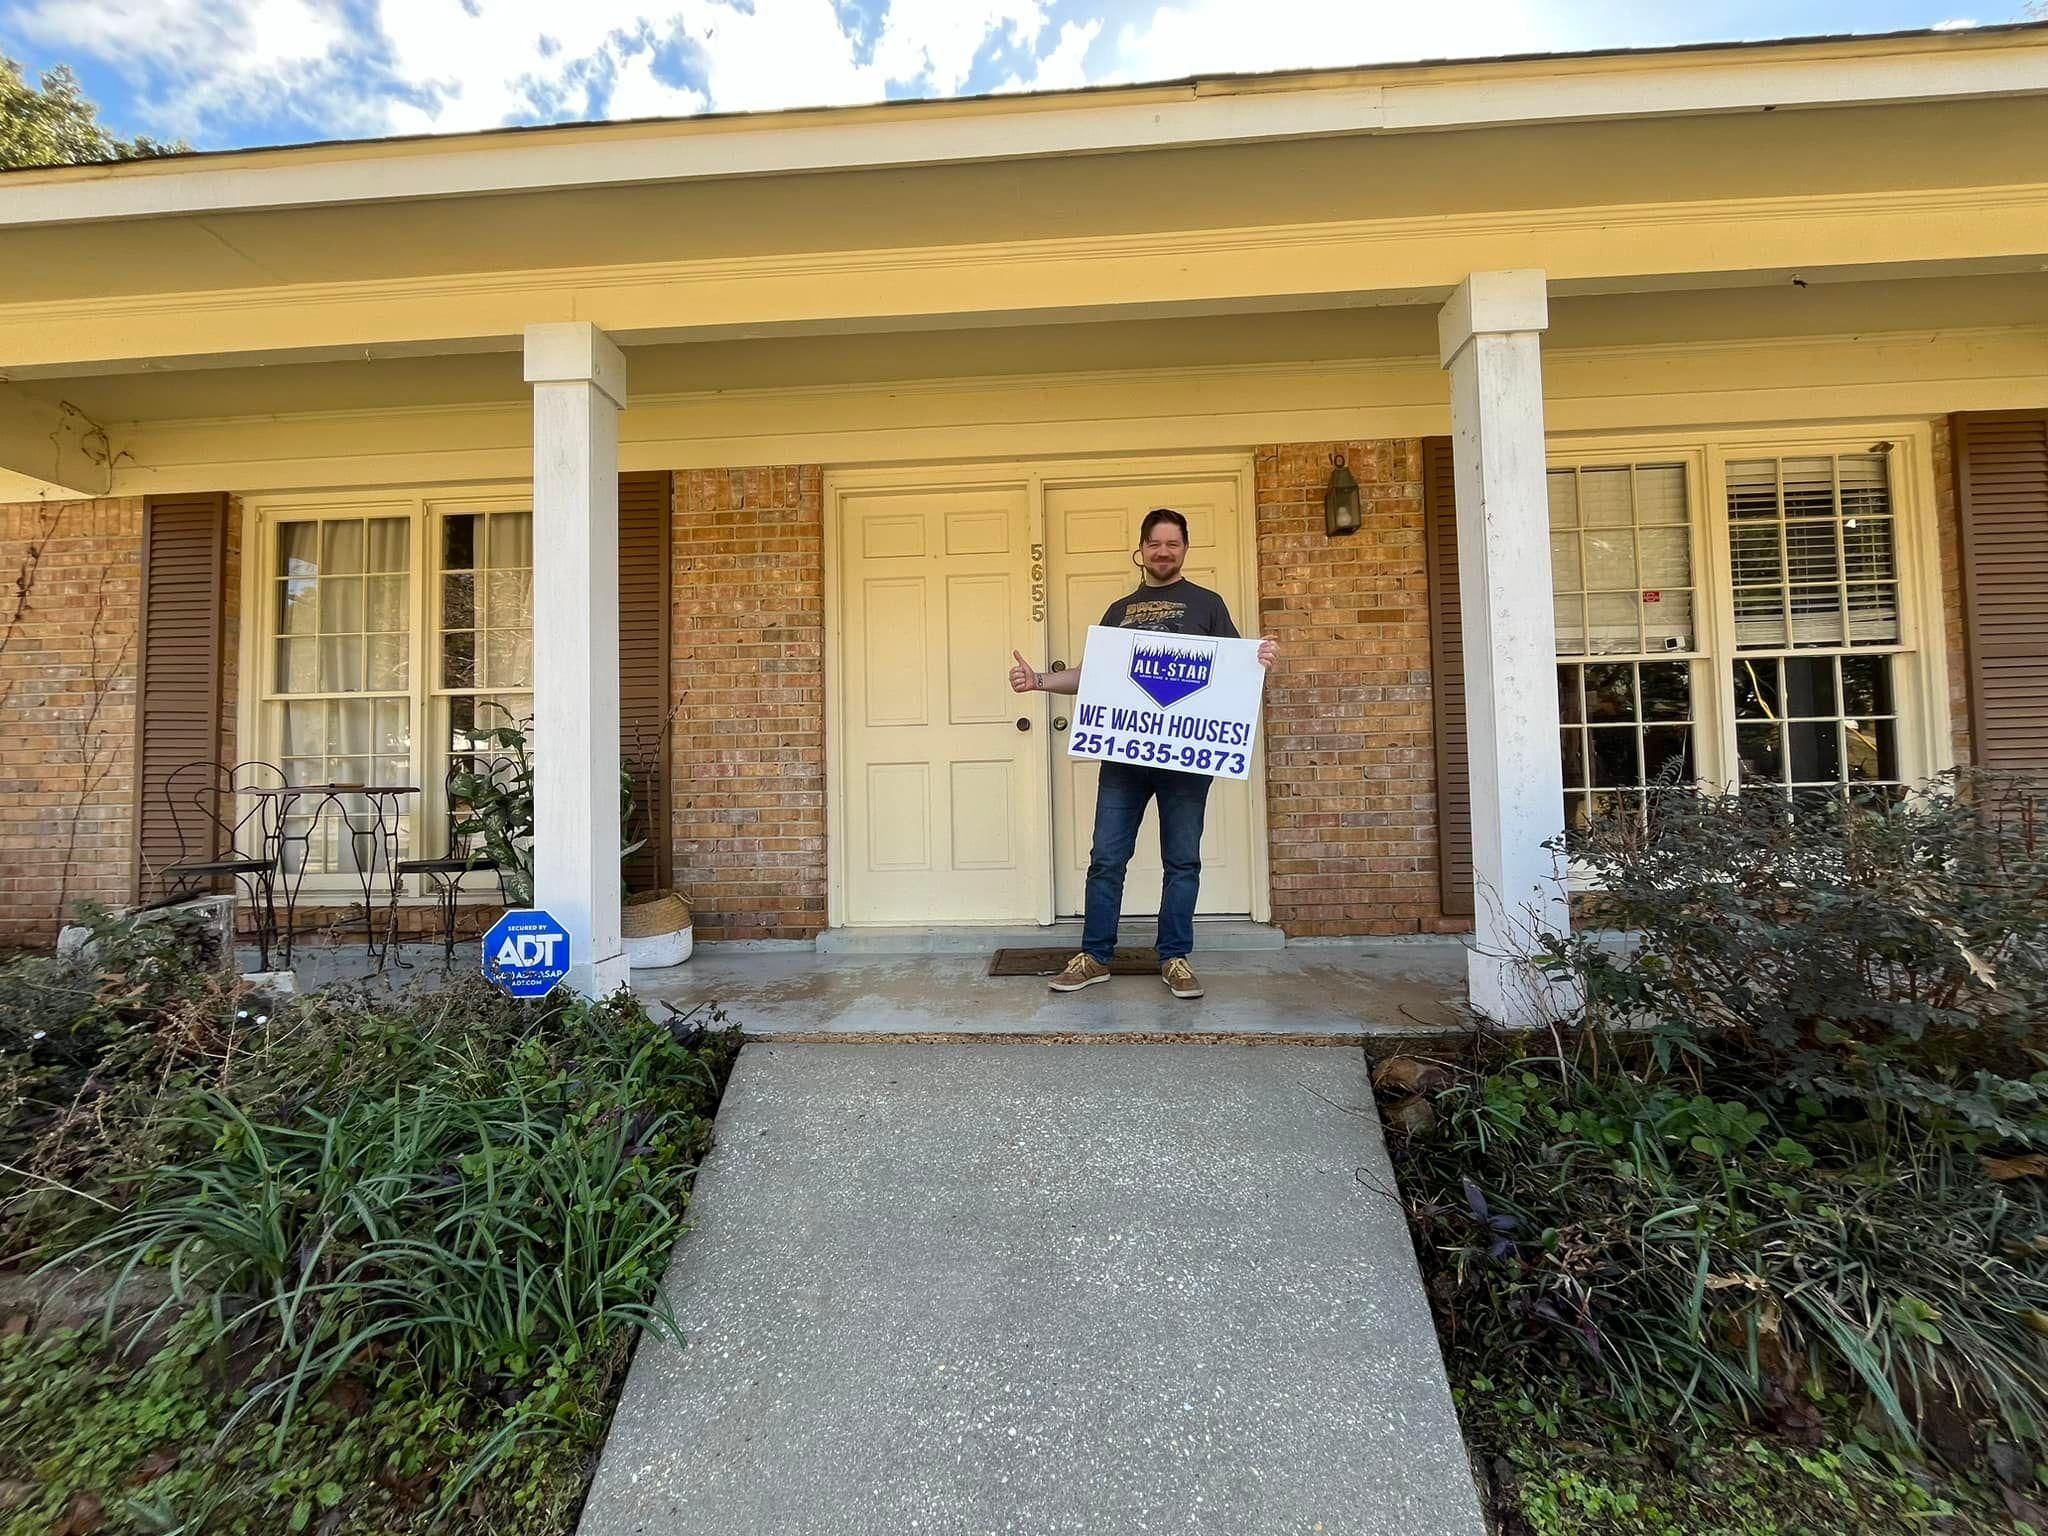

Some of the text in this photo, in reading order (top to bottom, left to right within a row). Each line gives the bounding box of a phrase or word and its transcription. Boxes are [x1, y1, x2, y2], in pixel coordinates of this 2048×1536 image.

[1031, 543, 1044, 622] 5655
[1133, 659, 1208, 681] ALL-STAR
[1079, 703, 1250, 747] WE WASH HOUSES!
[1071, 731, 1246, 775] 251-635-9873
[497, 933, 562, 967] ADT
